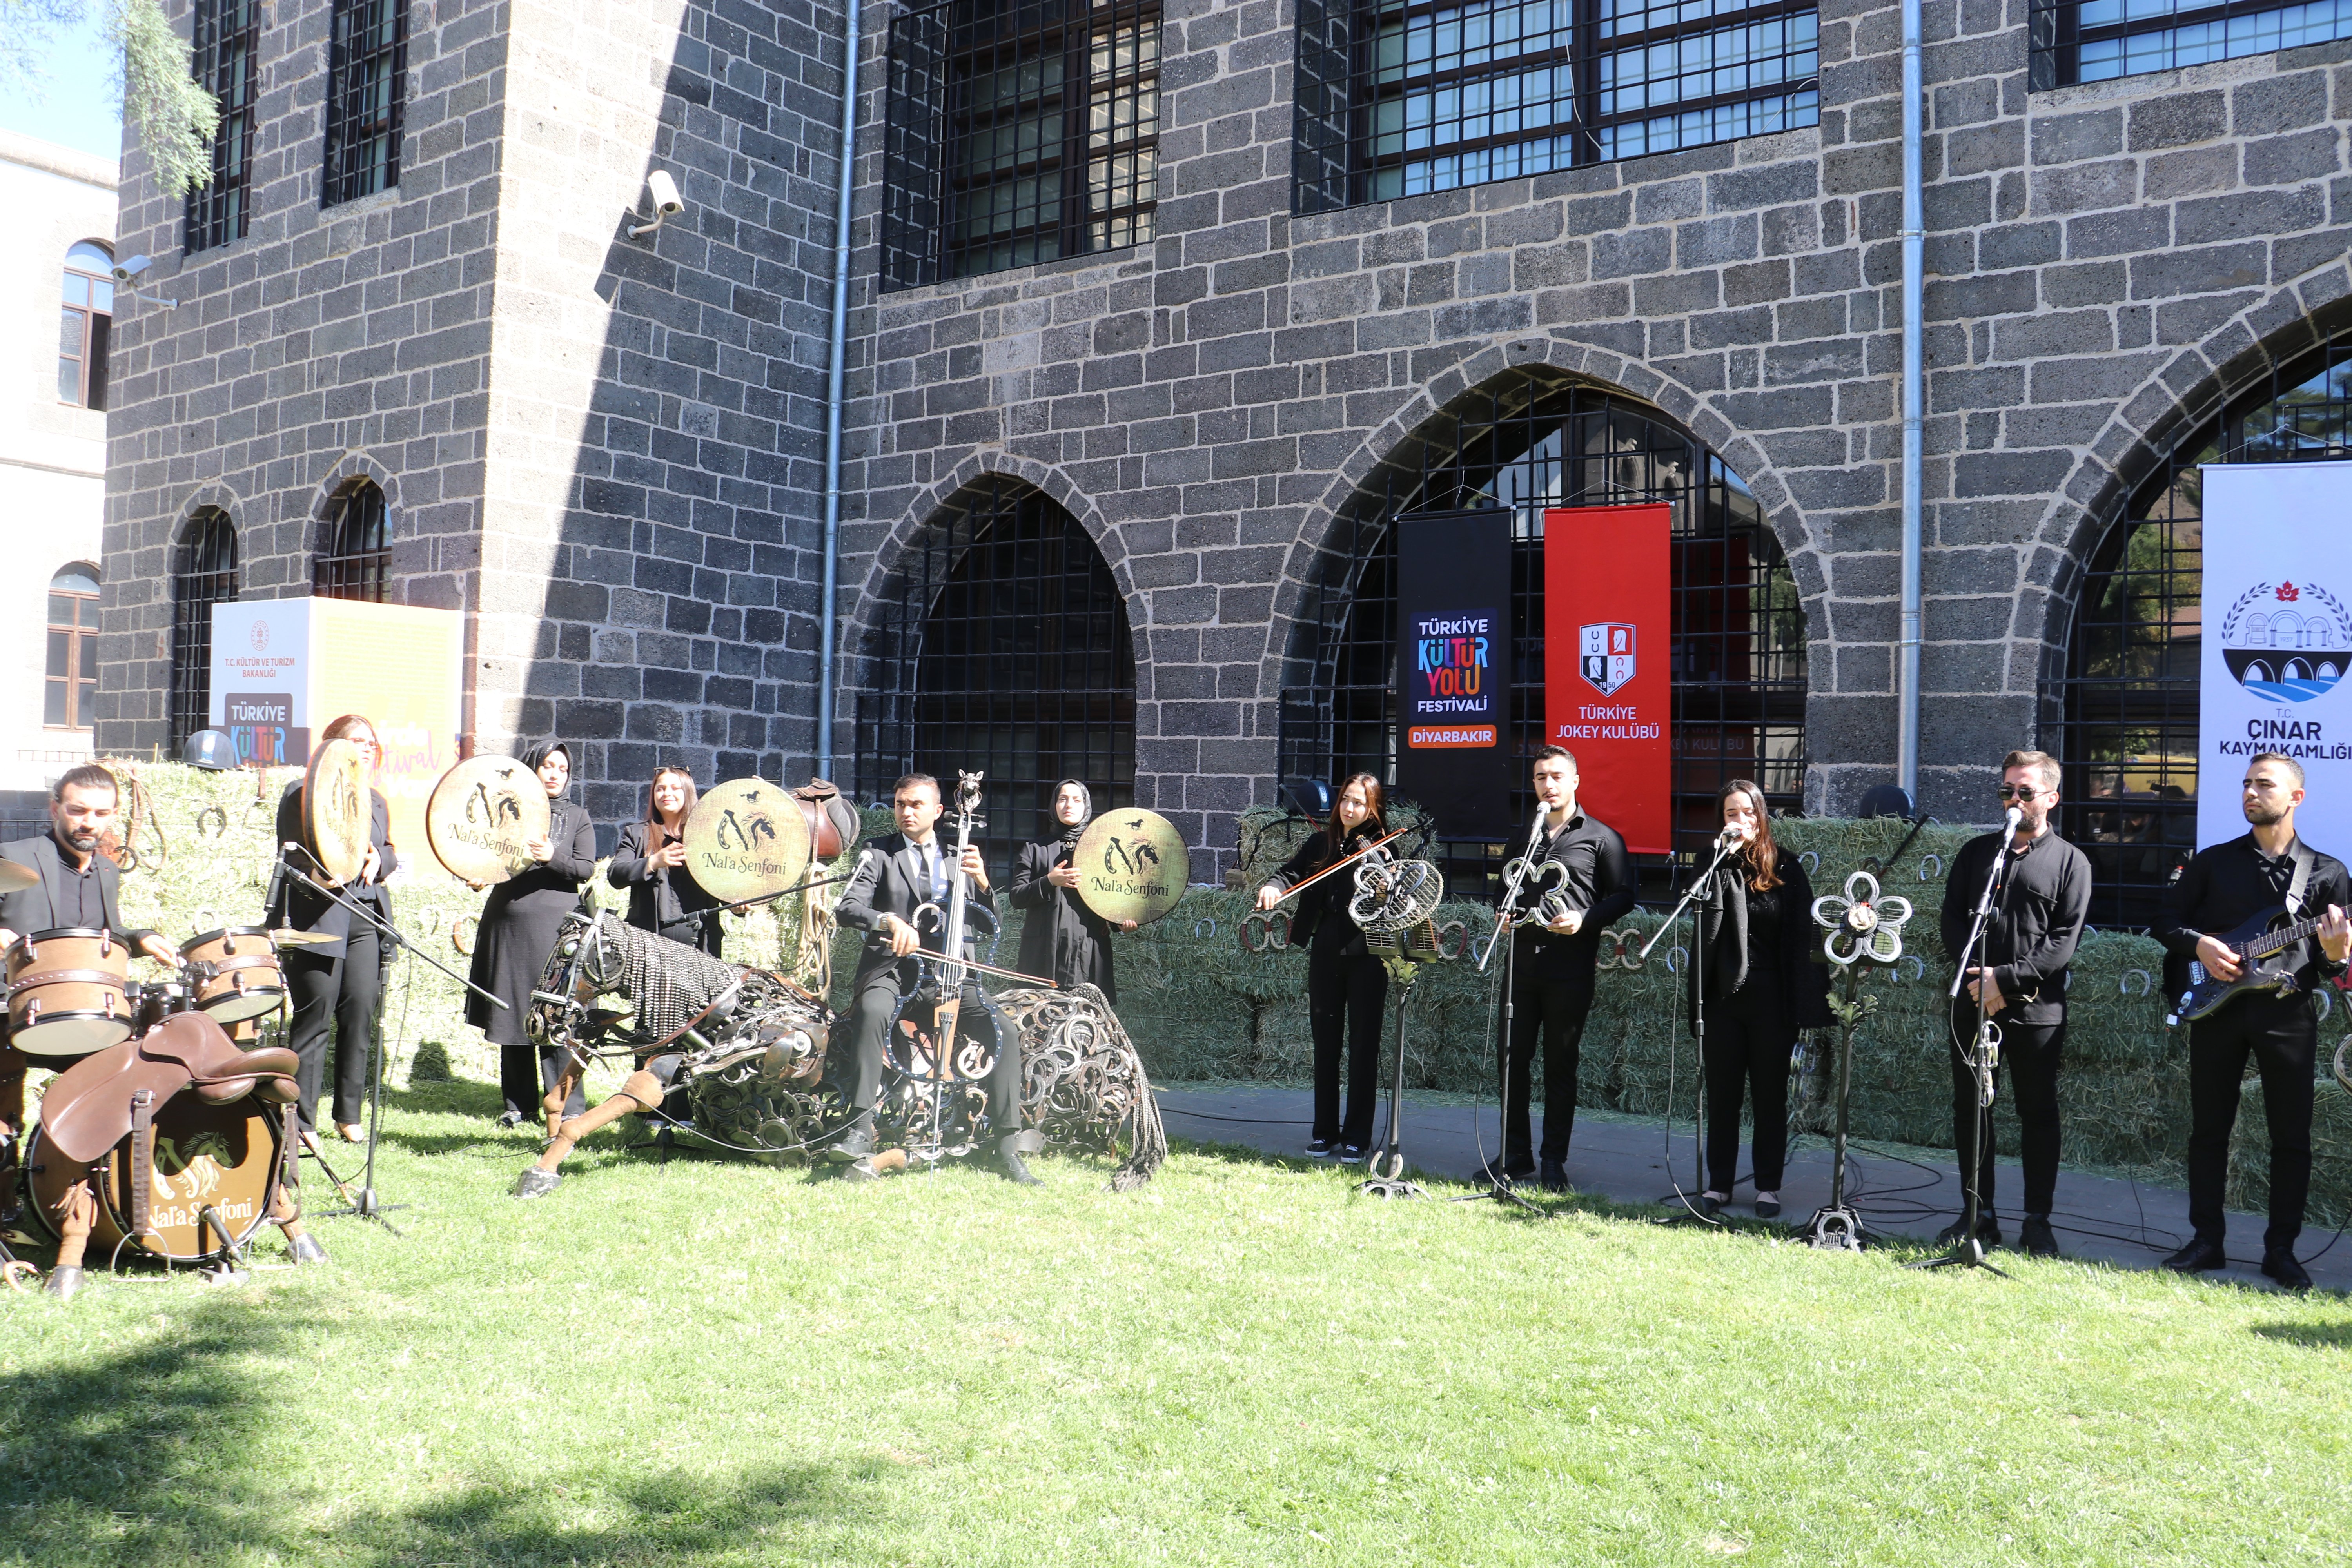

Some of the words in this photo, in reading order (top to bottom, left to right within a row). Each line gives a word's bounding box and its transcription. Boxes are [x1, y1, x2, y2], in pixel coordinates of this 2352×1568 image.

[1418, 616, 1488, 635] TÜRKİYE
[225, 658, 236, 667] T.C.
[236, 657, 260, 667] KÜLTÜR
[261, 658, 270, 666] VE
[270, 656, 295, 666] TURİZM
[1418, 637, 1488, 673] KÜLTÜR
[242, 668, 276, 678] BAKANLIĞI
[1427, 664, 1480, 696] YOLU
[231, 701, 286, 721] TÜRKİYE
[1417, 695, 1488, 713] FESTİVALİ
[1578, 704, 1637, 720] TÜRKİYE
[2276, 708, 2294, 718] T.C.
[1412, 728, 1492, 743] DİYARBAKIR
[1556, 725, 1599, 738] JOKEY
[1602, 722, 1659, 739] KULÜBÜ
[2247, 719, 2322, 740] ÇINAR
[231, 726, 286, 765] KÜLTÜR
[2220, 740, 2352, 760] KAYMAKAMLIĞI
[448, 823, 479, 845] Nal'a
[479, 833, 525, 857] Senfoni
[702, 853, 735, 869] Nal'a
[738, 856, 786, 877] Senfoni
[1091, 877, 1122, 892] Nal'a
[1124, 880, 1169, 899] Senfoni
[189, 1197, 252, 1227] Sfoni
